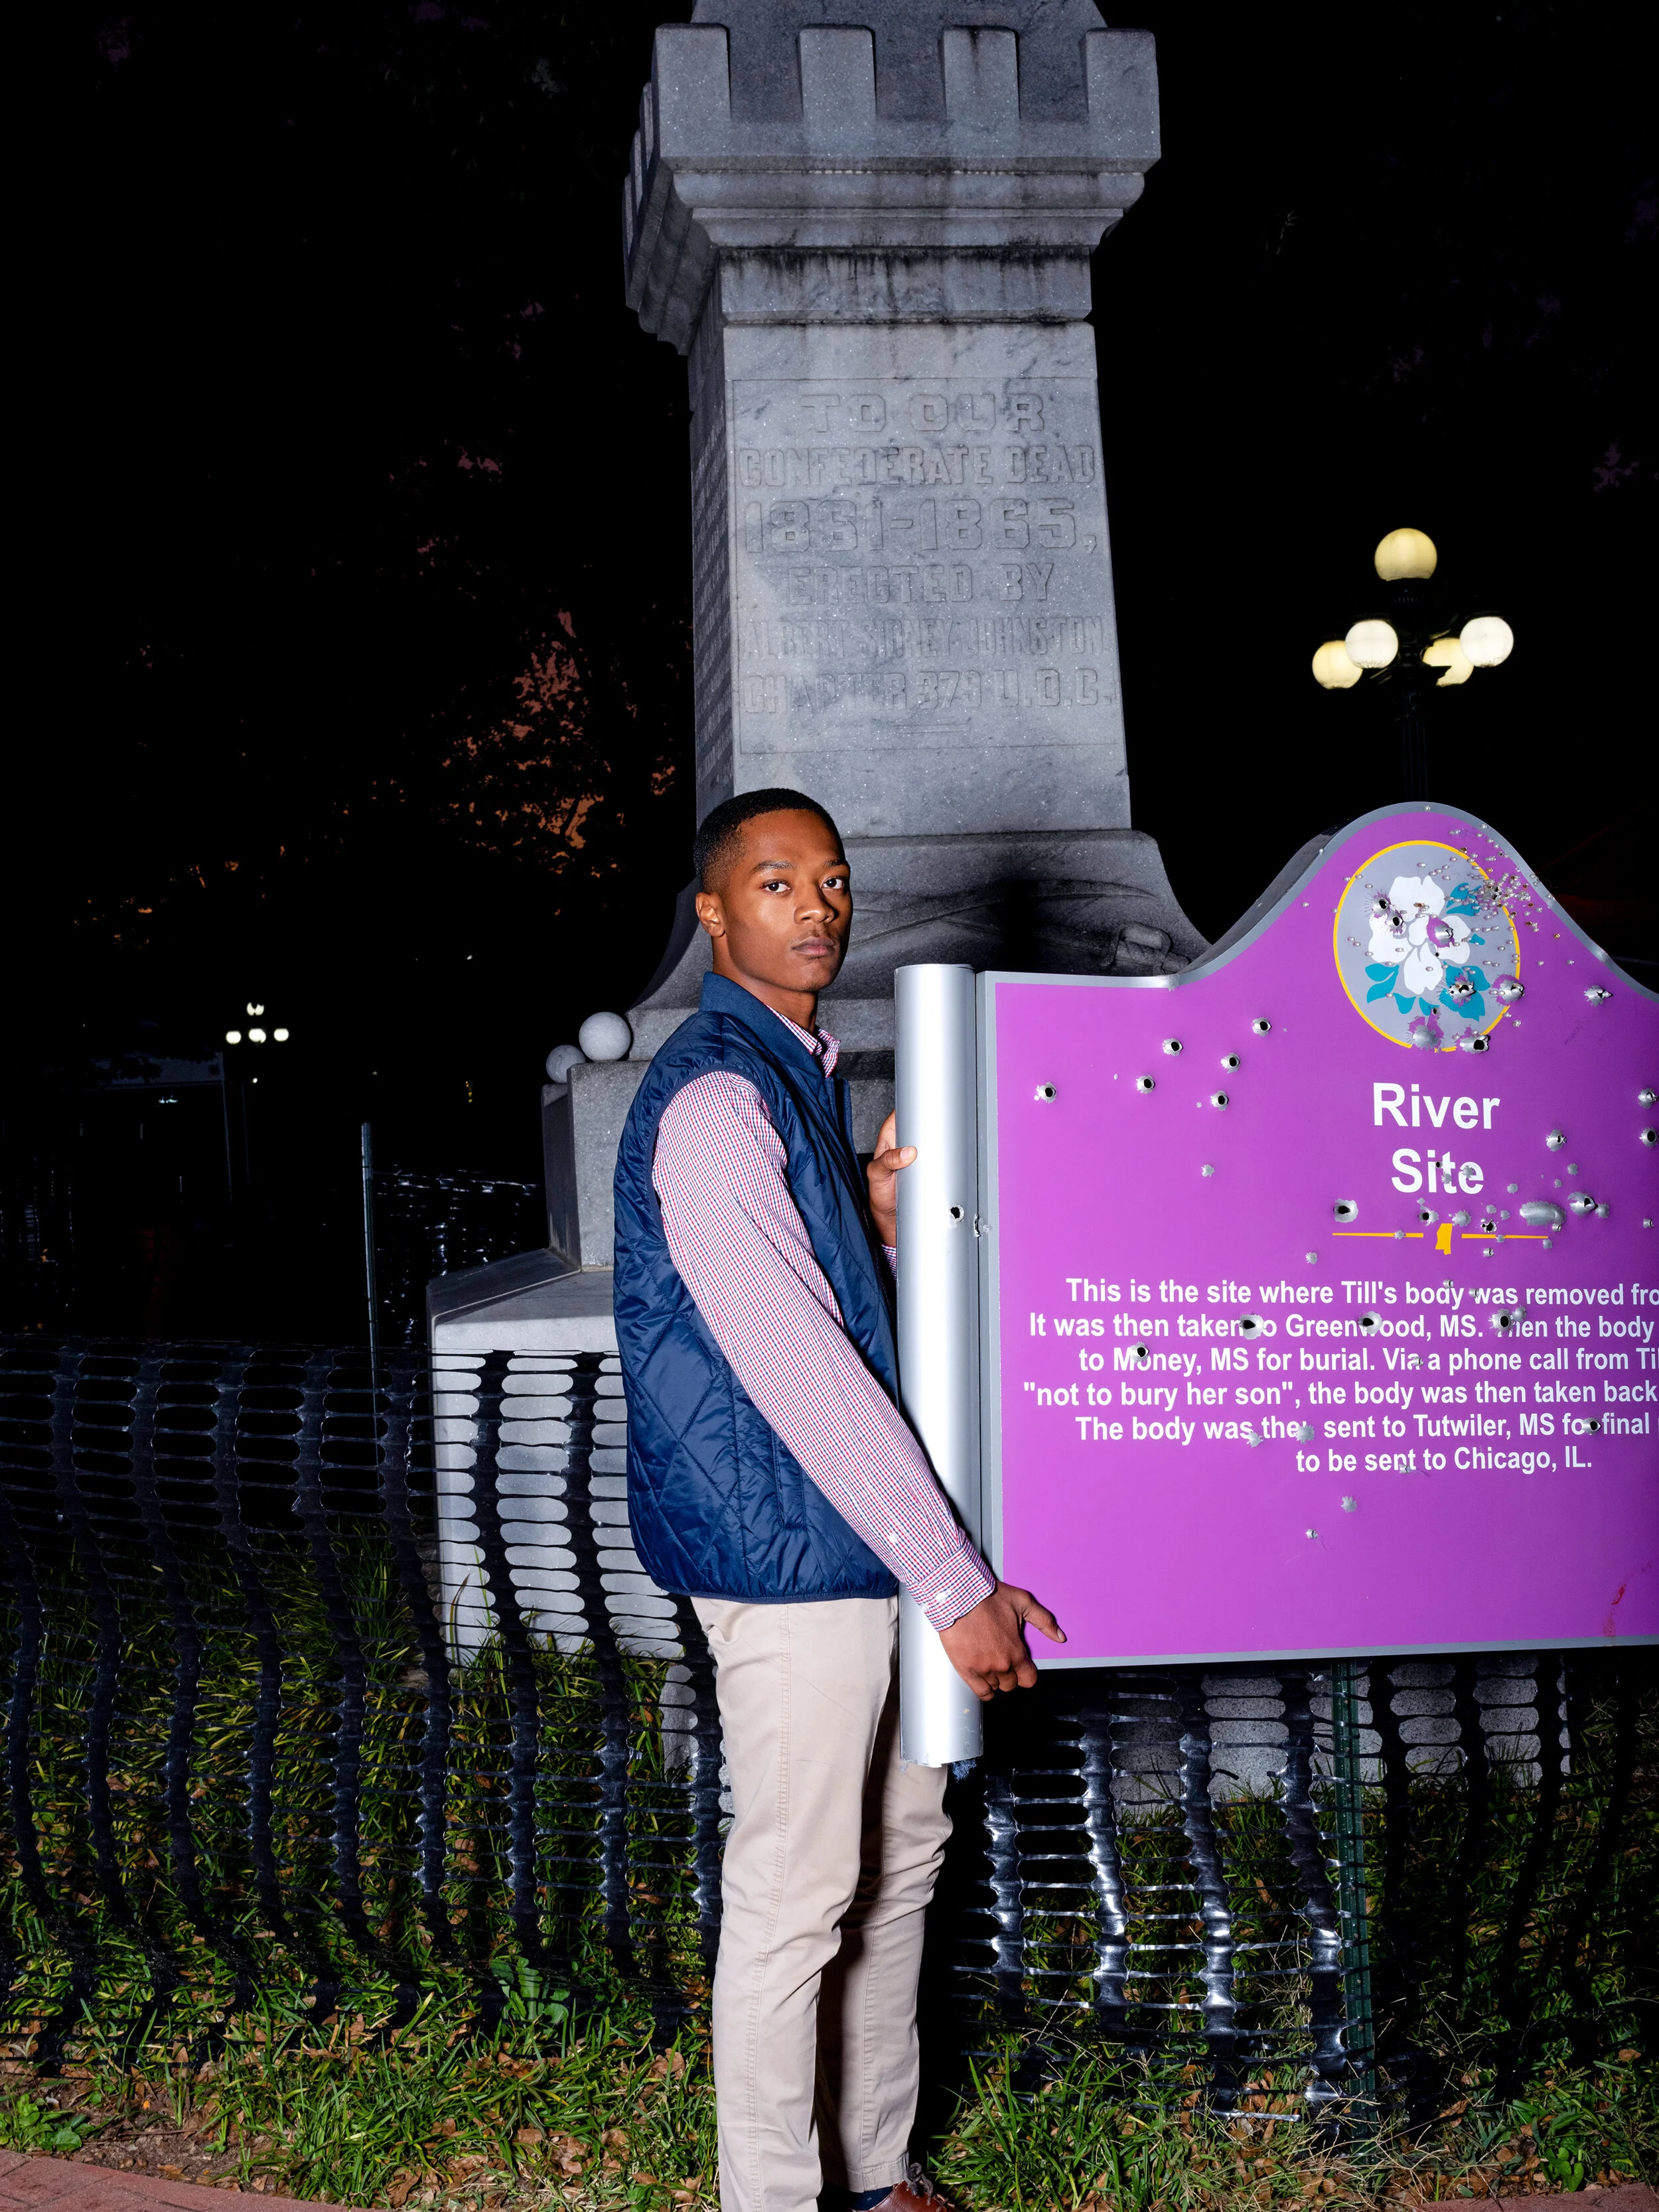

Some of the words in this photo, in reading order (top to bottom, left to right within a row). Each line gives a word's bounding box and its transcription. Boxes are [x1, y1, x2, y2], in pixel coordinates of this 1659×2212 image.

[801, 394, 885, 433] TO
[910, 393, 1045, 432] OUR
[740, 445, 993, 487] CONFEDERATE
[1005, 445, 1094, 484] DEAD
[788, 565, 972, 605] ERECTED
[999, 563, 1054, 602] BY
[744, 672, 907, 714] CHAPTER
[912, 670, 981, 711] 379
[1373, 1082, 1500, 1130] River
[1391, 1148, 1484, 1195] Site
[1065, 1278, 1121, 1302] This
[1130, 1278, 1151, 1303] is
[1159, 1279, 1199, 1303] the
[1206, 1280, 1252, 1303] site
[1258, 1280, 1334, 1304] where
[1340, 1280, 1398, 1304] Till's
[1406, 1280, 1465, 1310] body
[1471, 1286, 1519, 1305] was
[1526, 1283, 1624, 1305] removed
[1030, 1312, 1046, 1337] It
[1053, 1318, 1105, 1337] was
[1112, 1313, 1169, 1337] then
[1177, 1313, 1245, 1337] taken
[1440, 1314, 1483, 1337] MS.
[1555, 1315, 1591, 1337] the
[1599, 1315, 1654, 1343] body
[1078, 1348, 1105, 1371] to
[1211, 1347, 1249, 1371] MS
[1256, 1347, 1293, 1371] for
[1299, 1347, 1375, 1371] burial.
[1382, 1347, 1421, 1370] Via
[1427, 1353, 1441, 1370] a
[1449, 1347, 1522, 1376] phone
[1529, 1347, 1569, 1370] call
[1575, 1347, 1628, 1370] from
[1023, 1382, 1080, 1406] "not
[1086, 1382, 1112, 1406] to
[1121, 1381, 1179, 1412] bury
[1187, 1381, 1228, 1406] her
[1308, 1381, 1346, 1404] the
[1354, 1380, 1414, 1410] body
[1421, 1386, 1467, 1404] was
[1475, 1380, 1526, 1404] then
[1534, 1380, 1596, 1403] taken
[1604, 1380, 1658, 1402] back
[1075, 1416, 1123, 1441] The
[1132, 1416, 1196, 1446] body
[1202, 1420, 1254, 1440] was
[1262, 1415, 1315, 1439] the
[1323, 1415, 1376, 1438] sent
[1382, 1415, 1406, 1438] to
[1413, 1414, 1511, 1440] Tutwiler,
[1520, 1412, 1555, 1436] MS
[1562, 1412, 1593, 1435] fo
[1601, 1412, 1650, 1435] final
[1295, 1449, 1320, 1473] to
[1328, 1448, 1357, 1472] be
[1364, 1448, 1417, 1472] sent
[1423, 1448, 1447, 1471] to
[1454, 1446, 1557, 1475] Chicago,
[1565, 1445, 1592, 1468] IL.
